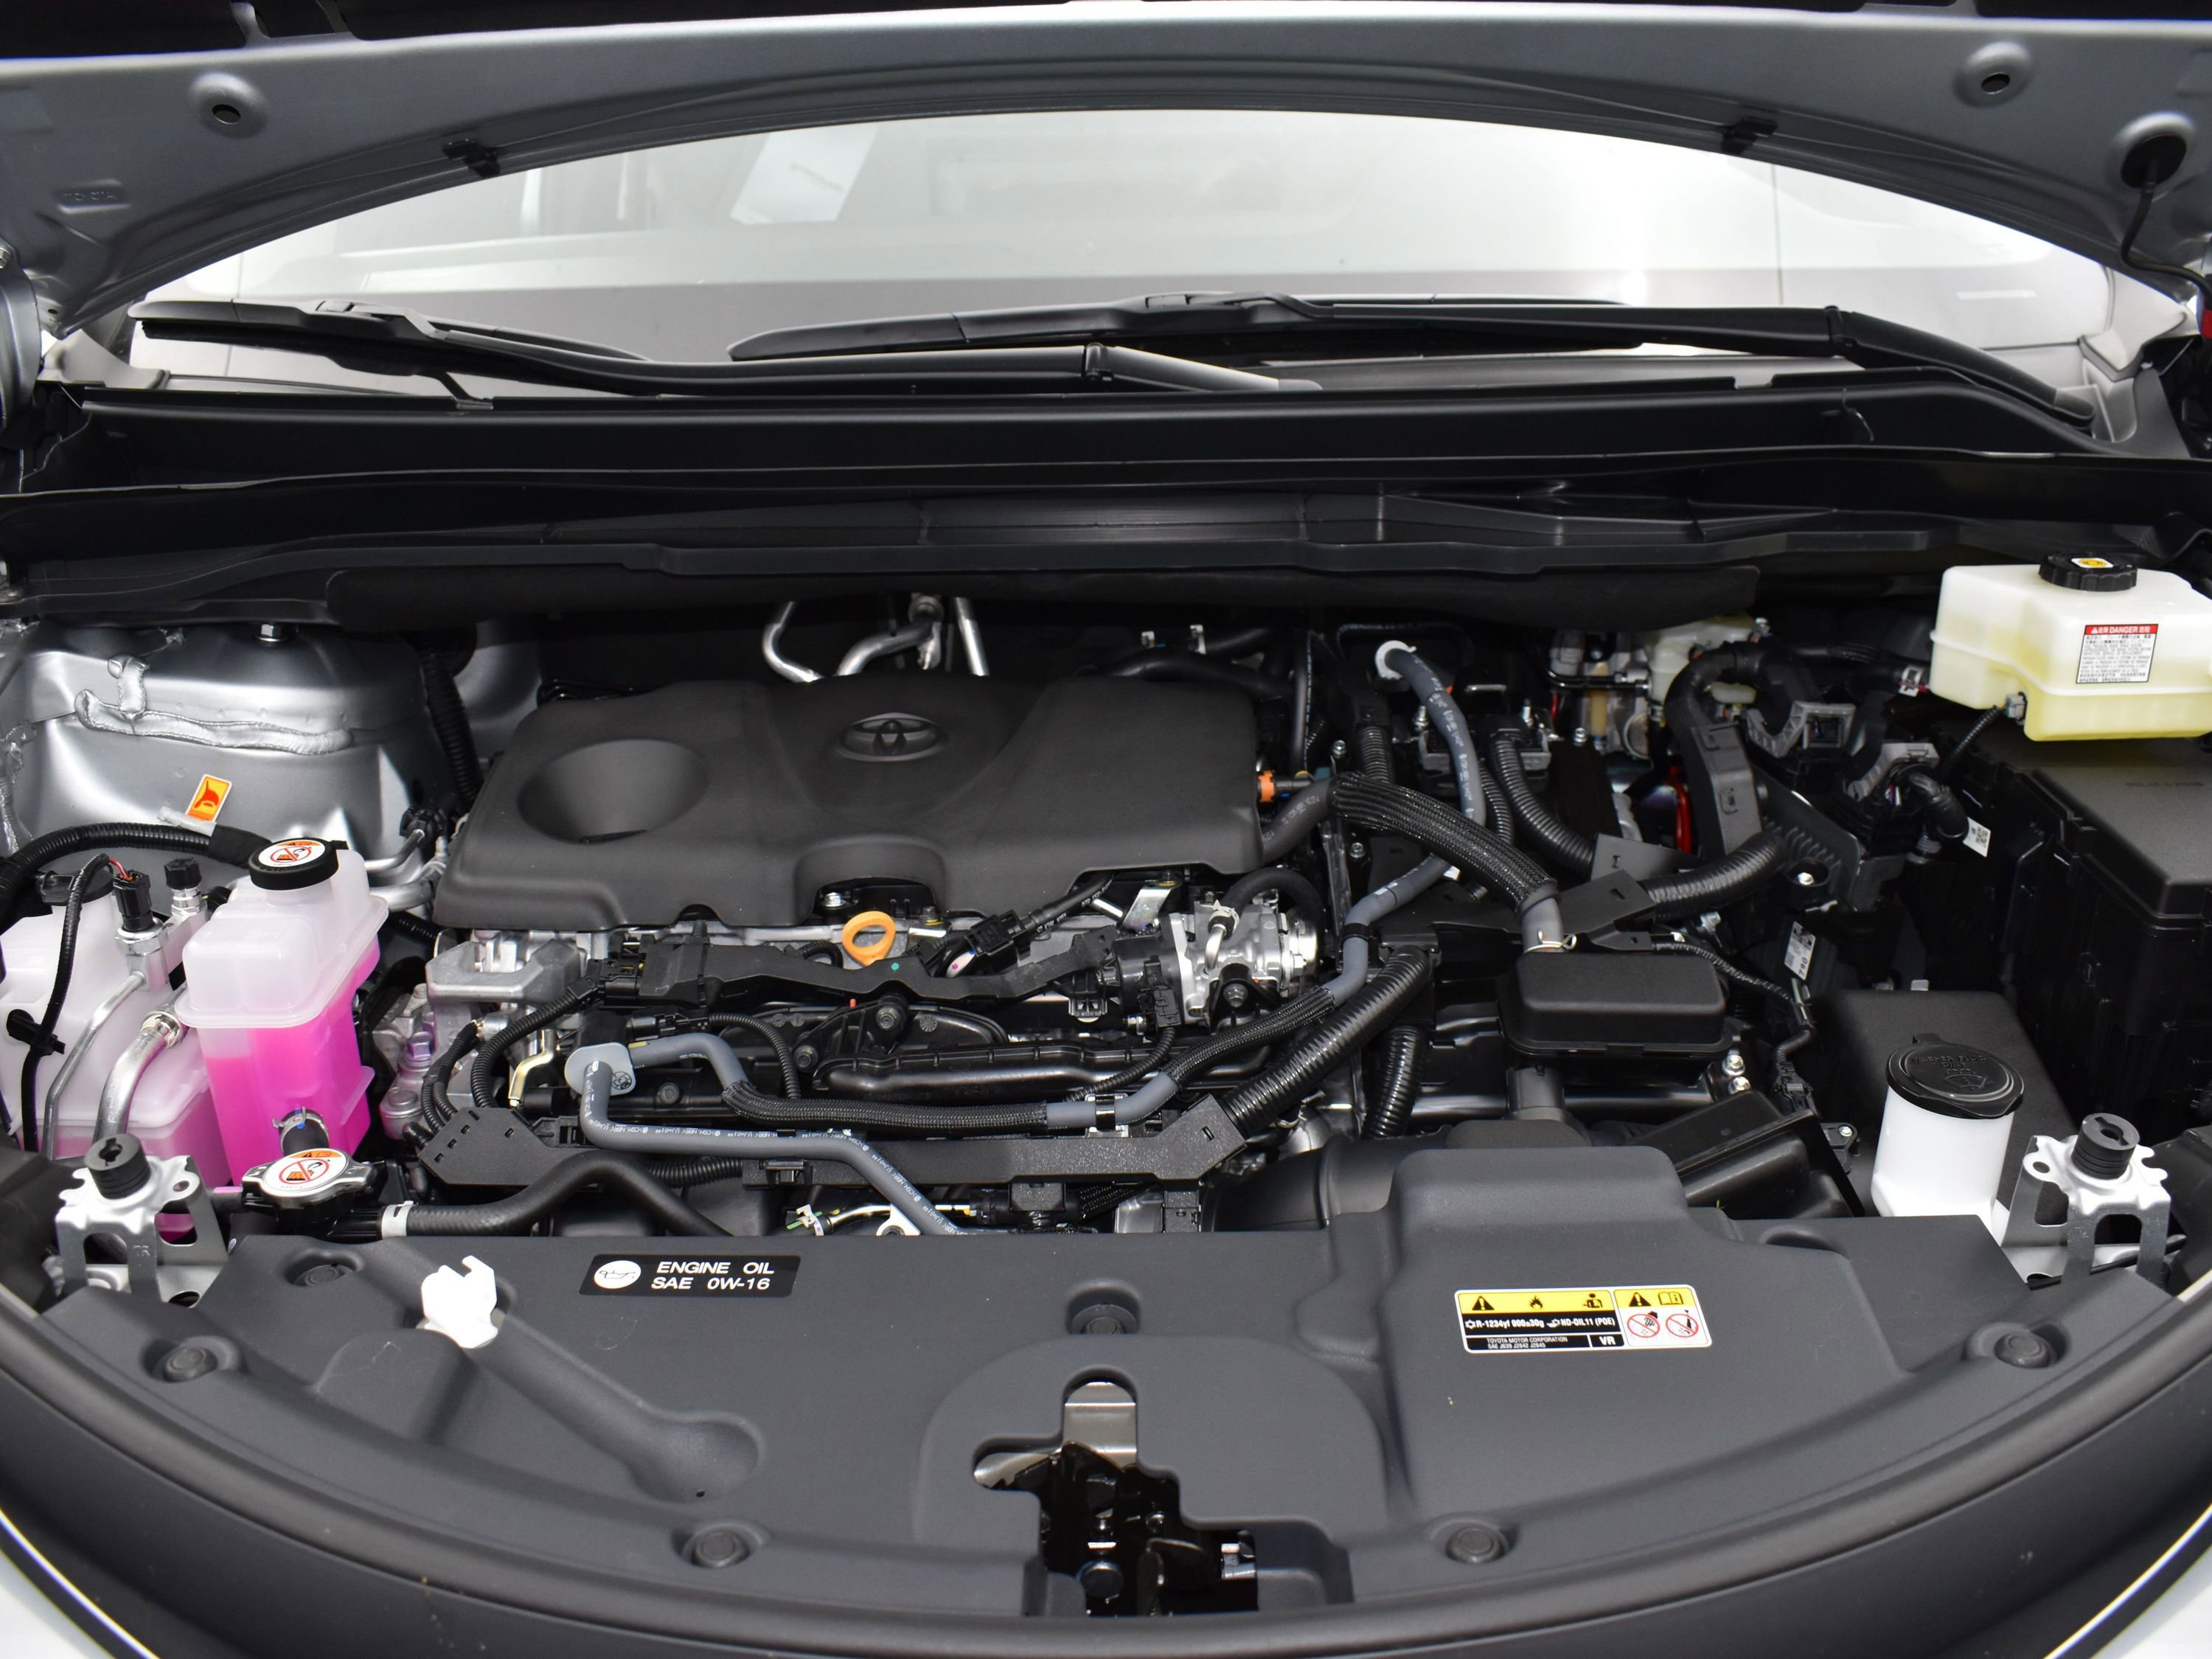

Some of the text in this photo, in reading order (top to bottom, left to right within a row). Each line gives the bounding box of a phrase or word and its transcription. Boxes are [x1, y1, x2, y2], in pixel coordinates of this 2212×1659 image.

[656, 1262, 775, 1274] ENGINE OIL
[650, 1277, 770, 1290] SAE 0W-16
[1595, 1317, 1615, 1326] (POE)
[1599, 1336, 1616, 1346] VR
